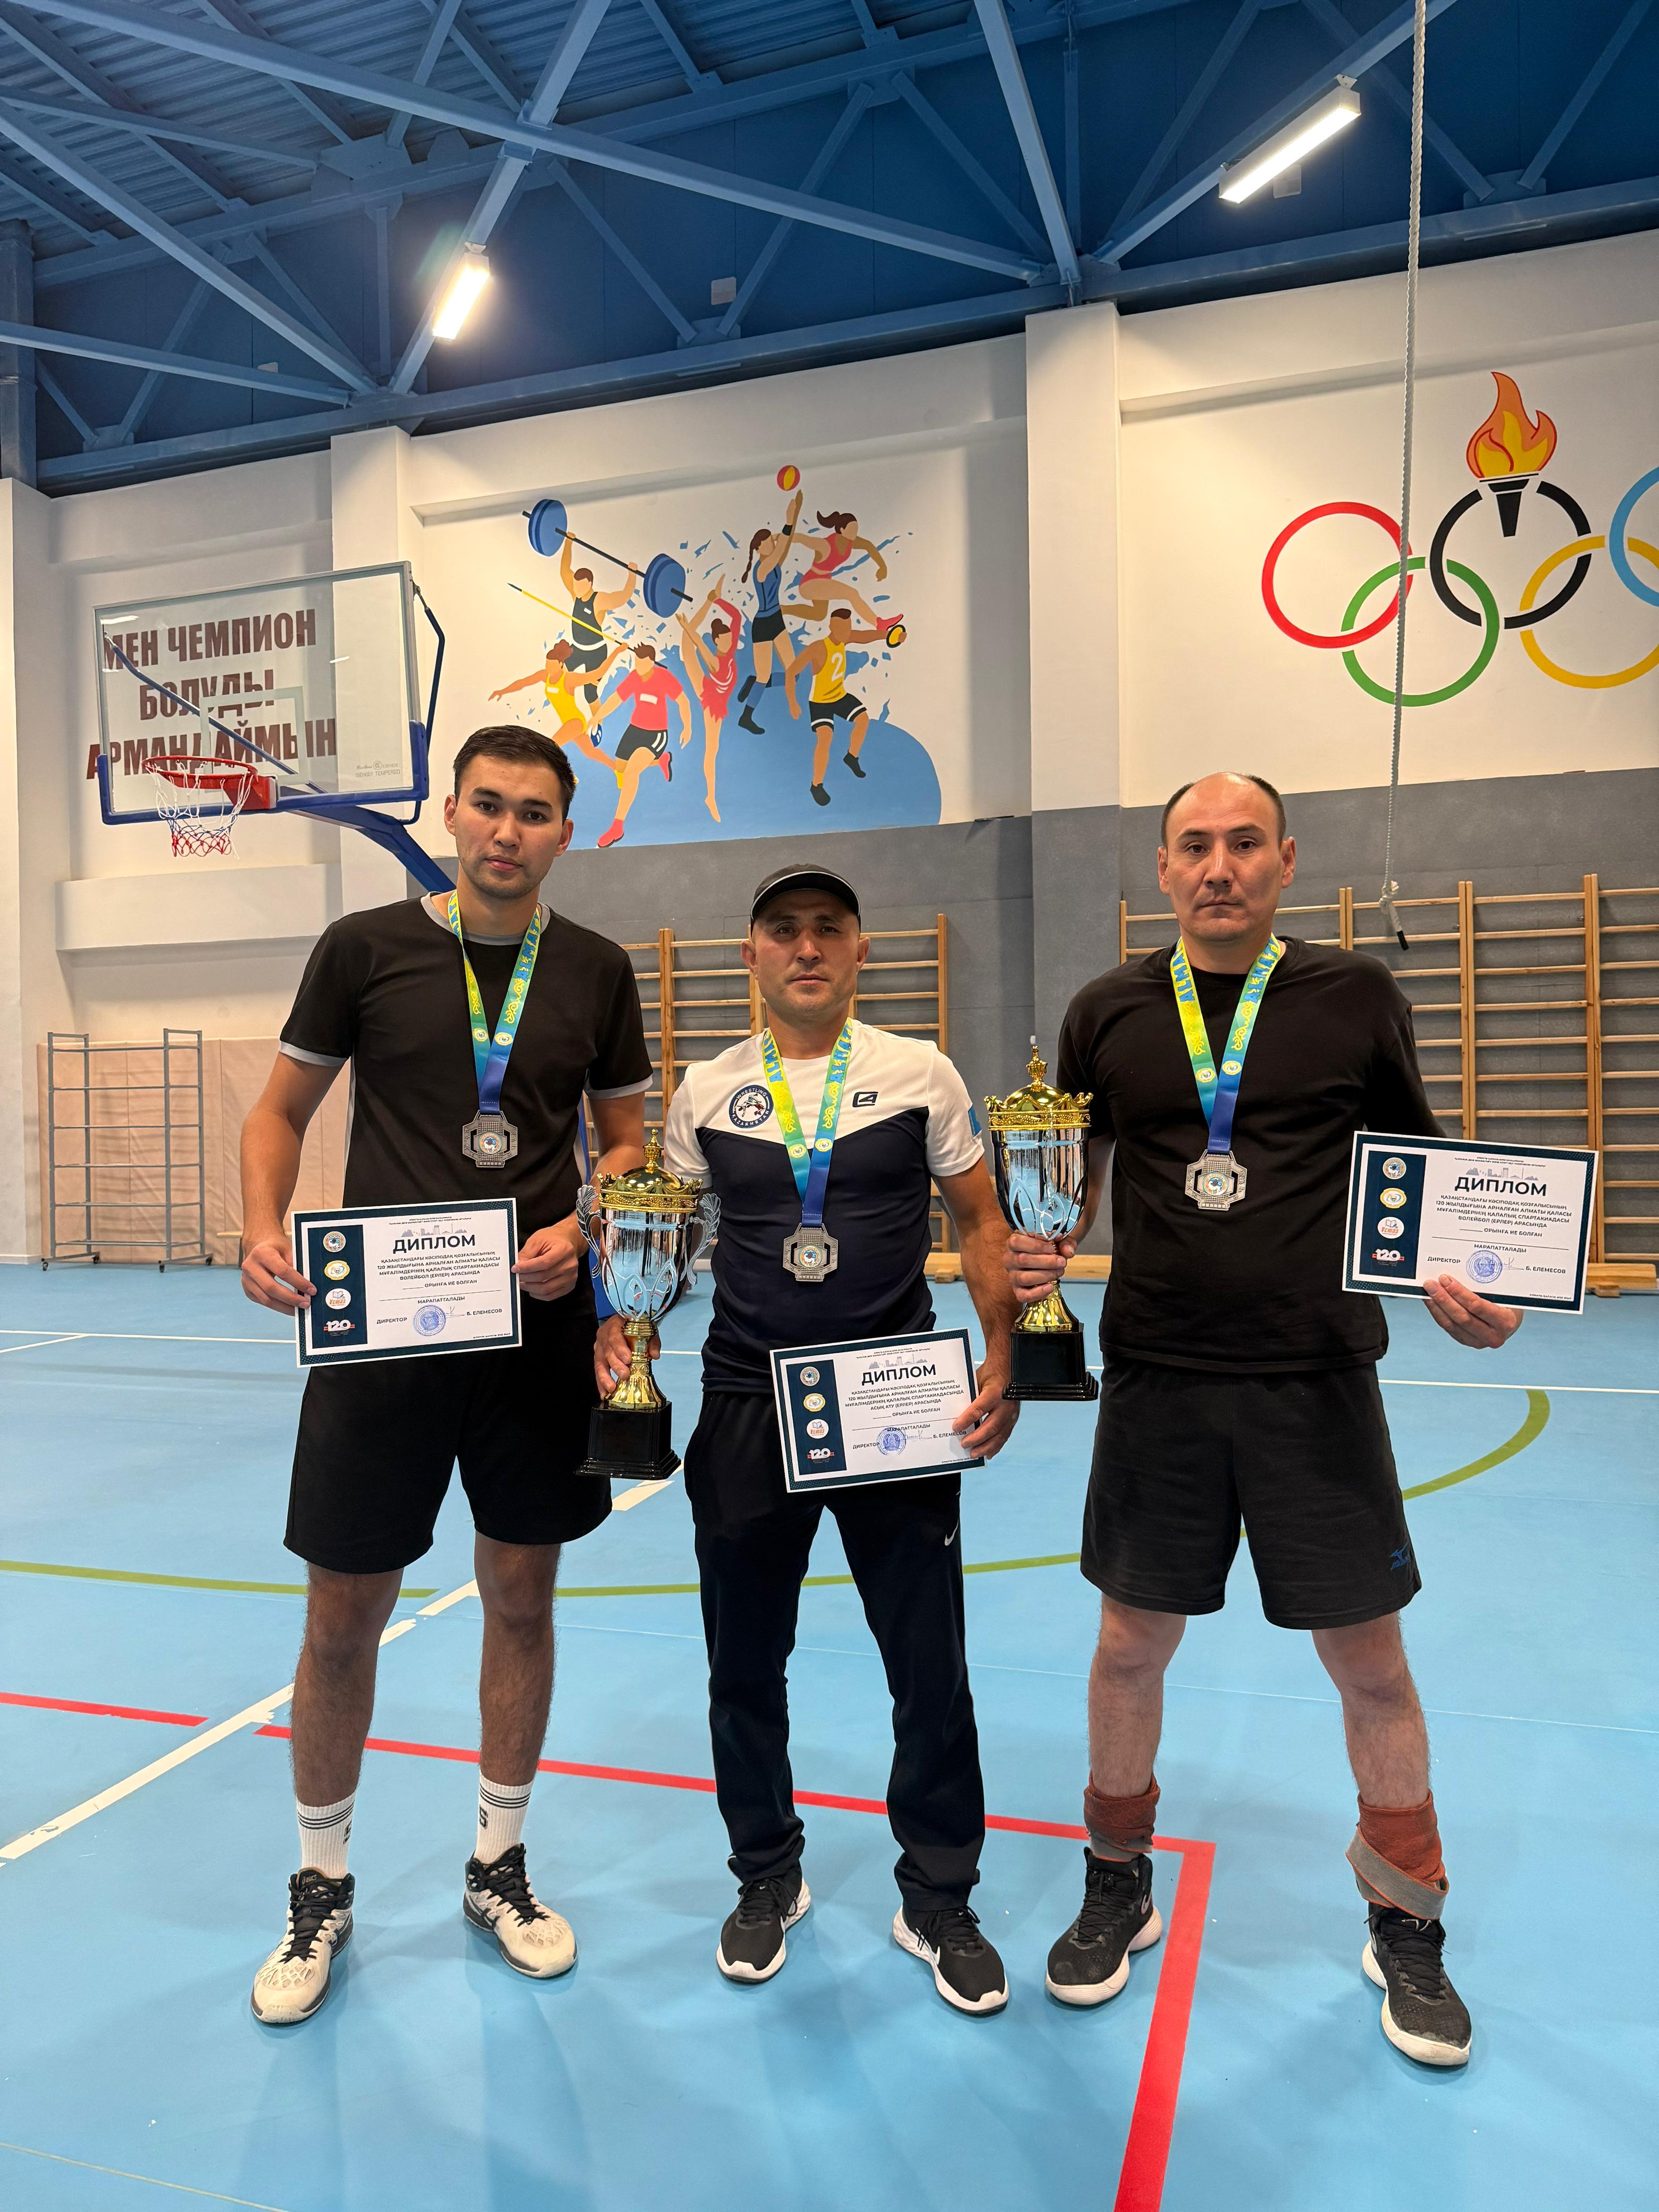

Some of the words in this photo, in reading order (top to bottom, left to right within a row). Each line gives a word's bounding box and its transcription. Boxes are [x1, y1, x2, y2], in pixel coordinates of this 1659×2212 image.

[104, 630, 158, 669] МЕН
[167, 609, 316, 662] ЧЕМПИОН
[736, 1087, 767, 1100] WRESTLING
[732, 1110, 769, 1126] KAZAKHSTAN
[1454, 1176, 1547, 1197] ДИПЛОМ
[392, 1234, 475, 1254] ДИПЛОМ
[1375, 1249, 1401, 1261] 120
[326, 1319, 351, 1332] 120
[861, 1364, 936, 1386] ДИПЛОМ
[809, 1447, 831, 1459] 120
